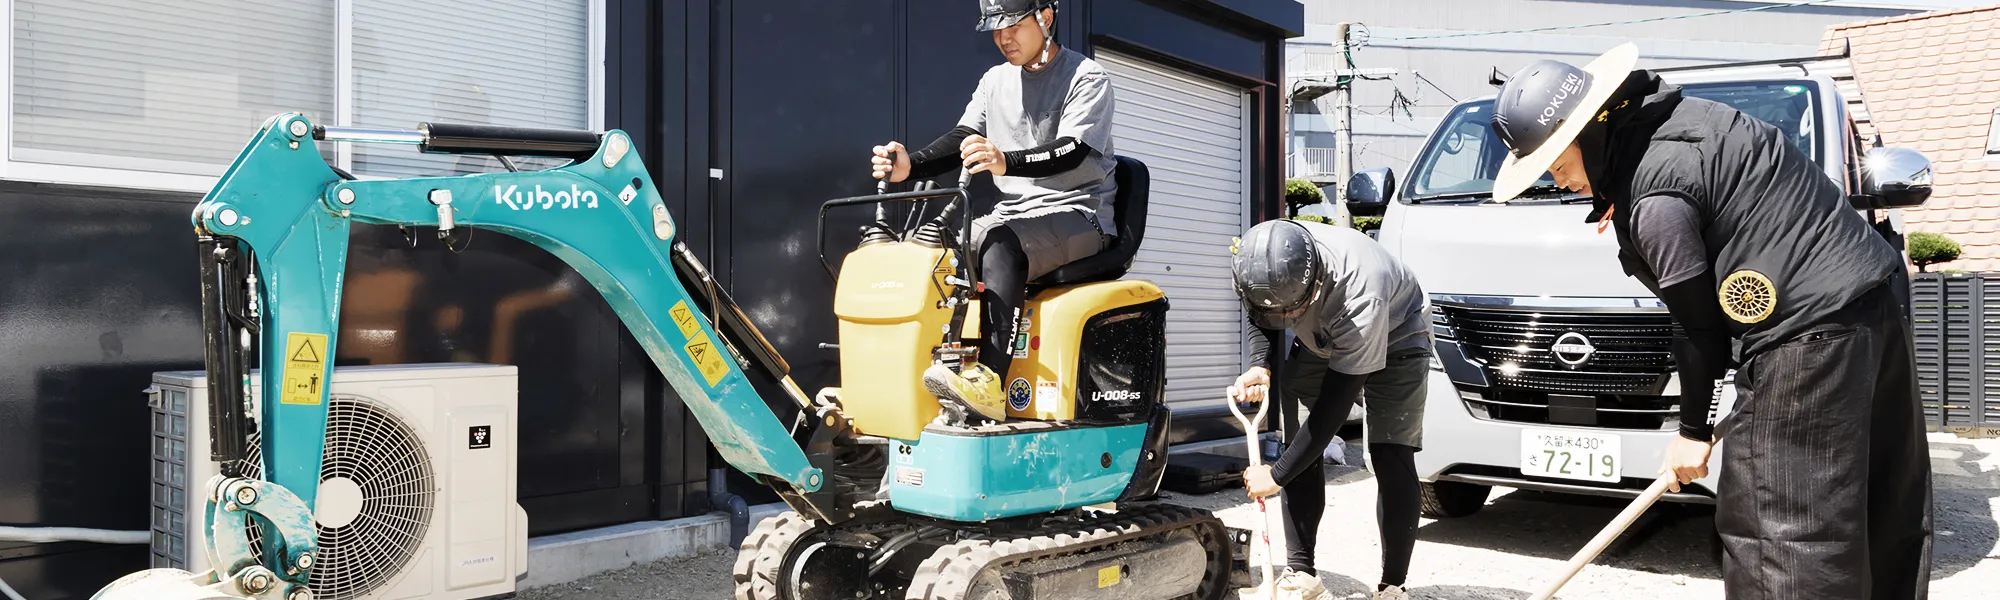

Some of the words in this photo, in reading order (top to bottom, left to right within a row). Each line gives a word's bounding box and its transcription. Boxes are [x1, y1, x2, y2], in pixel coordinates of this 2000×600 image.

[1537, 72, 1579, 126] KOKUEKI
[495, 184, 598, 210] Kubota
[1006, 307, 1020, 355] BURTLE
[1529, 454, 1538, 466] さ
[1543, 449, 1614, 478] 72-19
